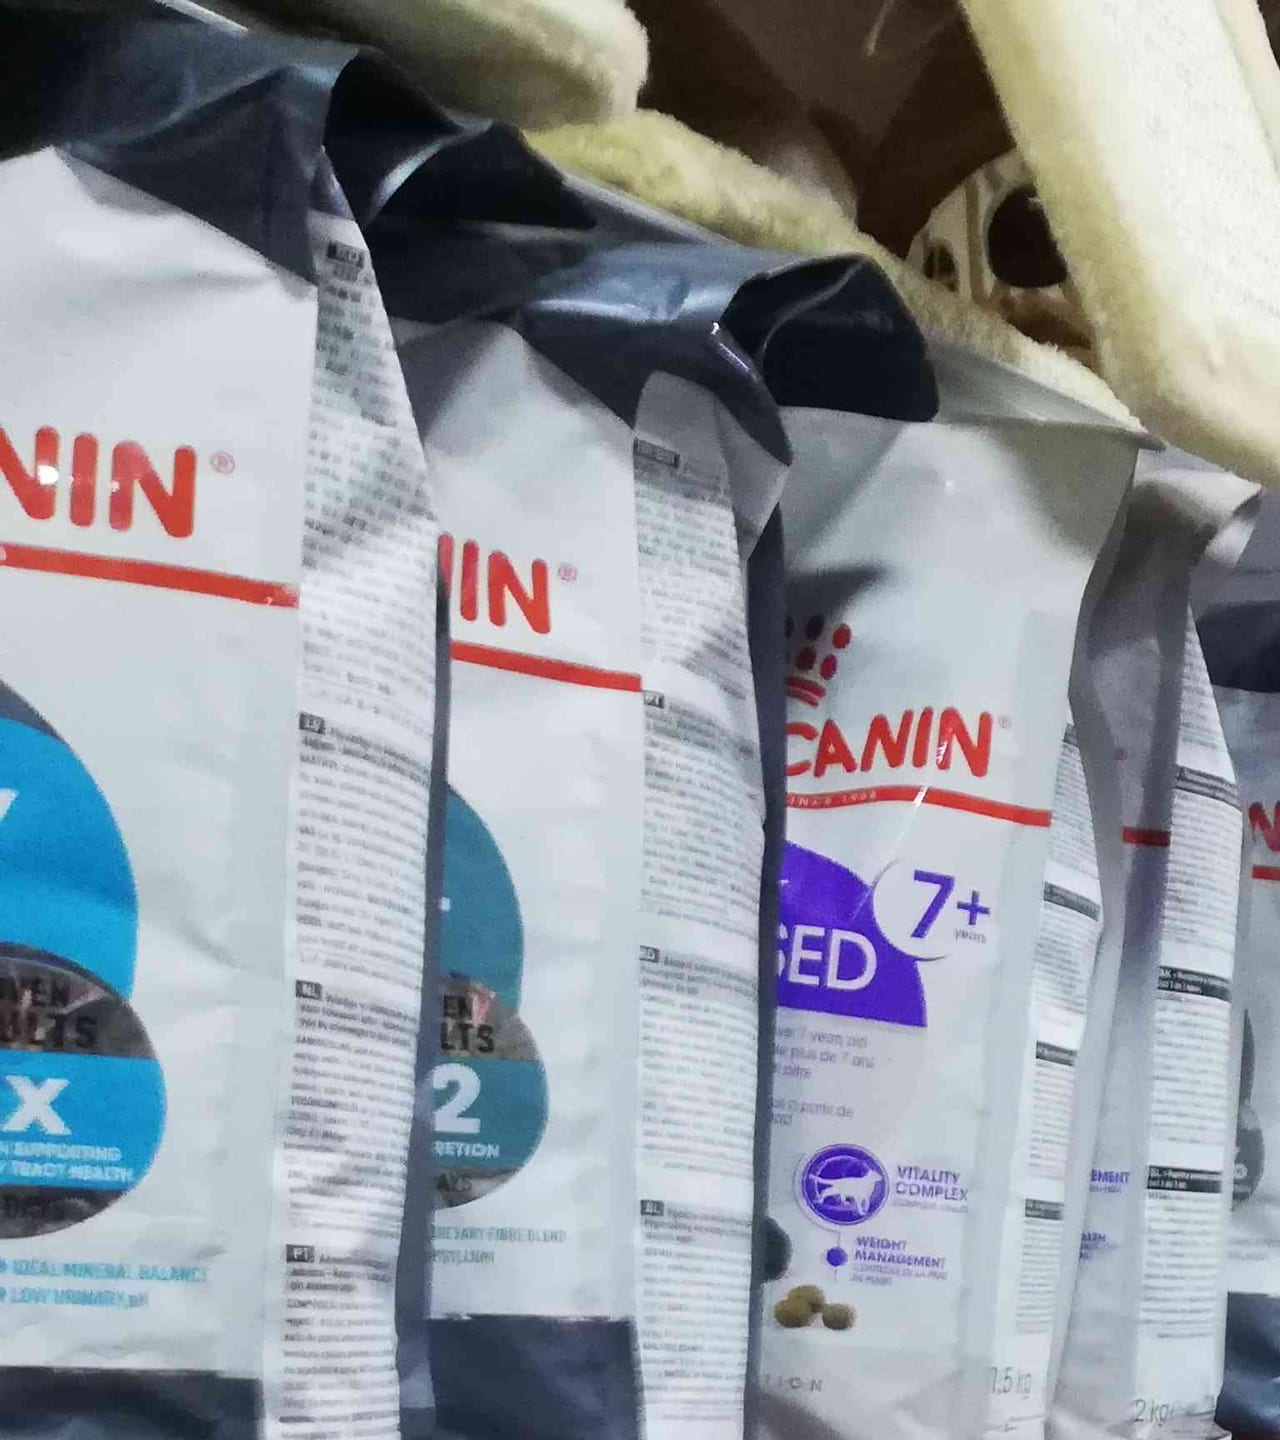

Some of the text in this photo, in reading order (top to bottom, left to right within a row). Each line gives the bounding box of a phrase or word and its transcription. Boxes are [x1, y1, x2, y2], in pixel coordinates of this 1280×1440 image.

[431, 1062, 481, 1134] 2
[897, 1166, 961, 1184] VITALITY
[895, 1182, 969, 1201] COMPLEX
[856, 1236, 907, 1251] WEIGHT
[854, 1250, 946, 1270] MANAGEMENT
